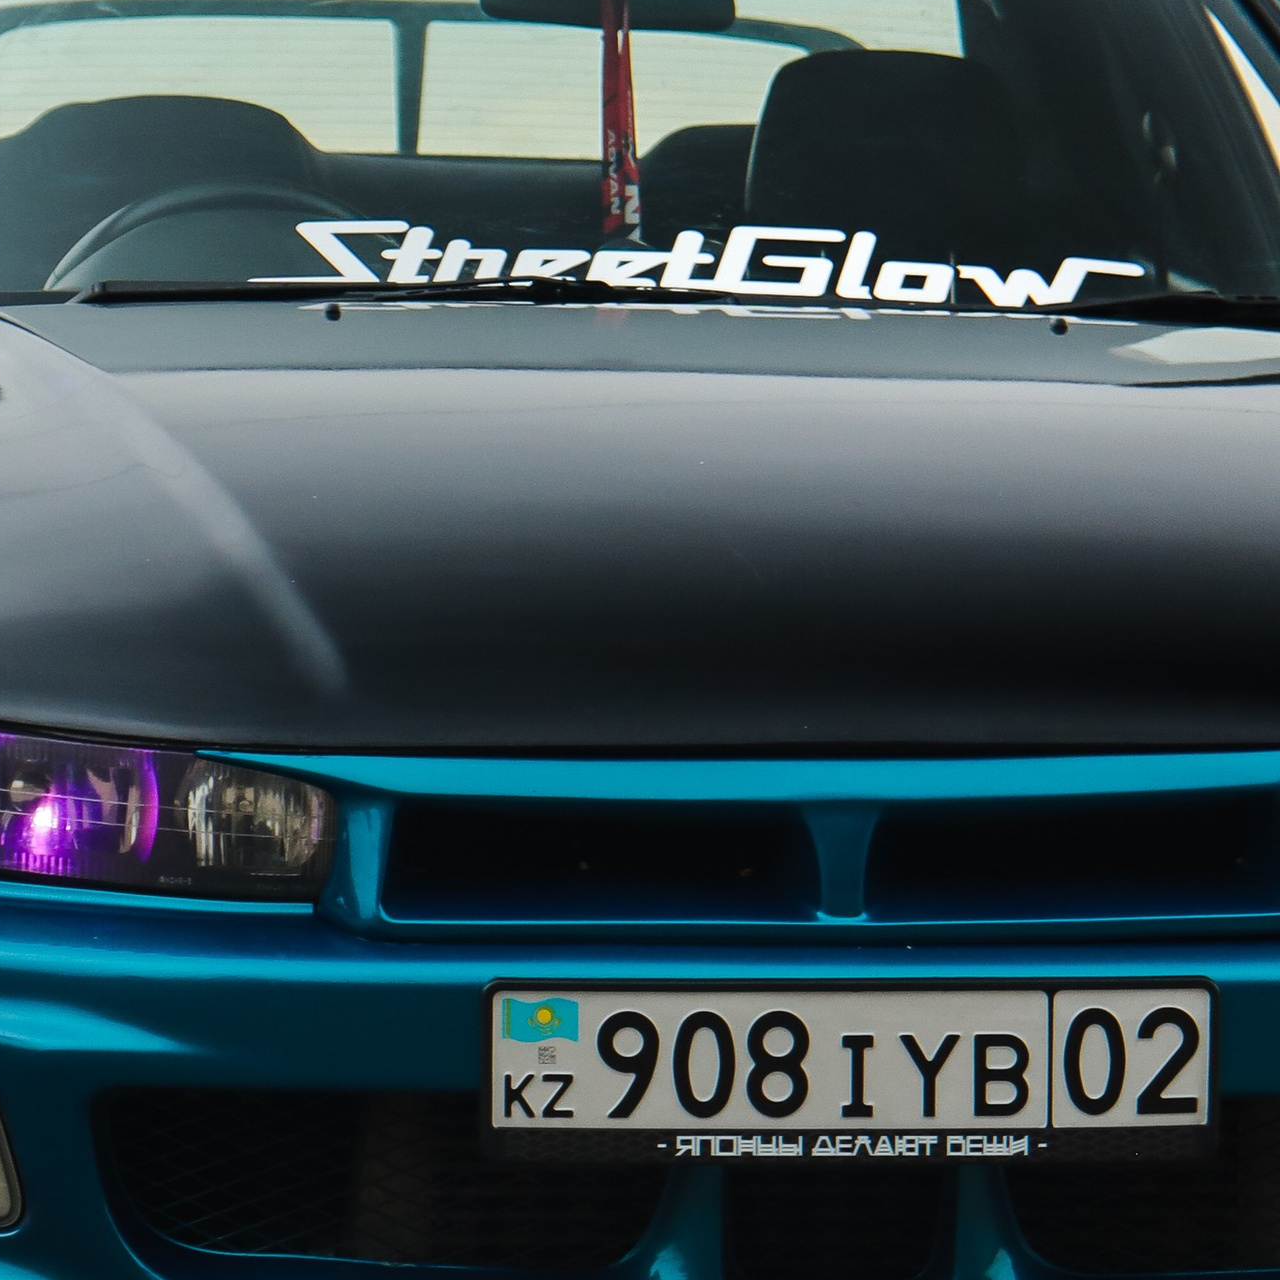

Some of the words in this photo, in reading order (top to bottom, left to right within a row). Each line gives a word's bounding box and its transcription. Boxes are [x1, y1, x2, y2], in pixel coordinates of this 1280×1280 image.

[247, 220, 1145, 308] StreetGlow
[1063, 1006, 1200, 1117] 02
[503, 1073, 574, 1119] KZ
[675, 1135, 803, 1157] ЯПОНЦЫ
[811, 1135, 938, 1157] ДЕЛАЮТ
[946, 1135, 1029, 1156] ВЕЩИ
